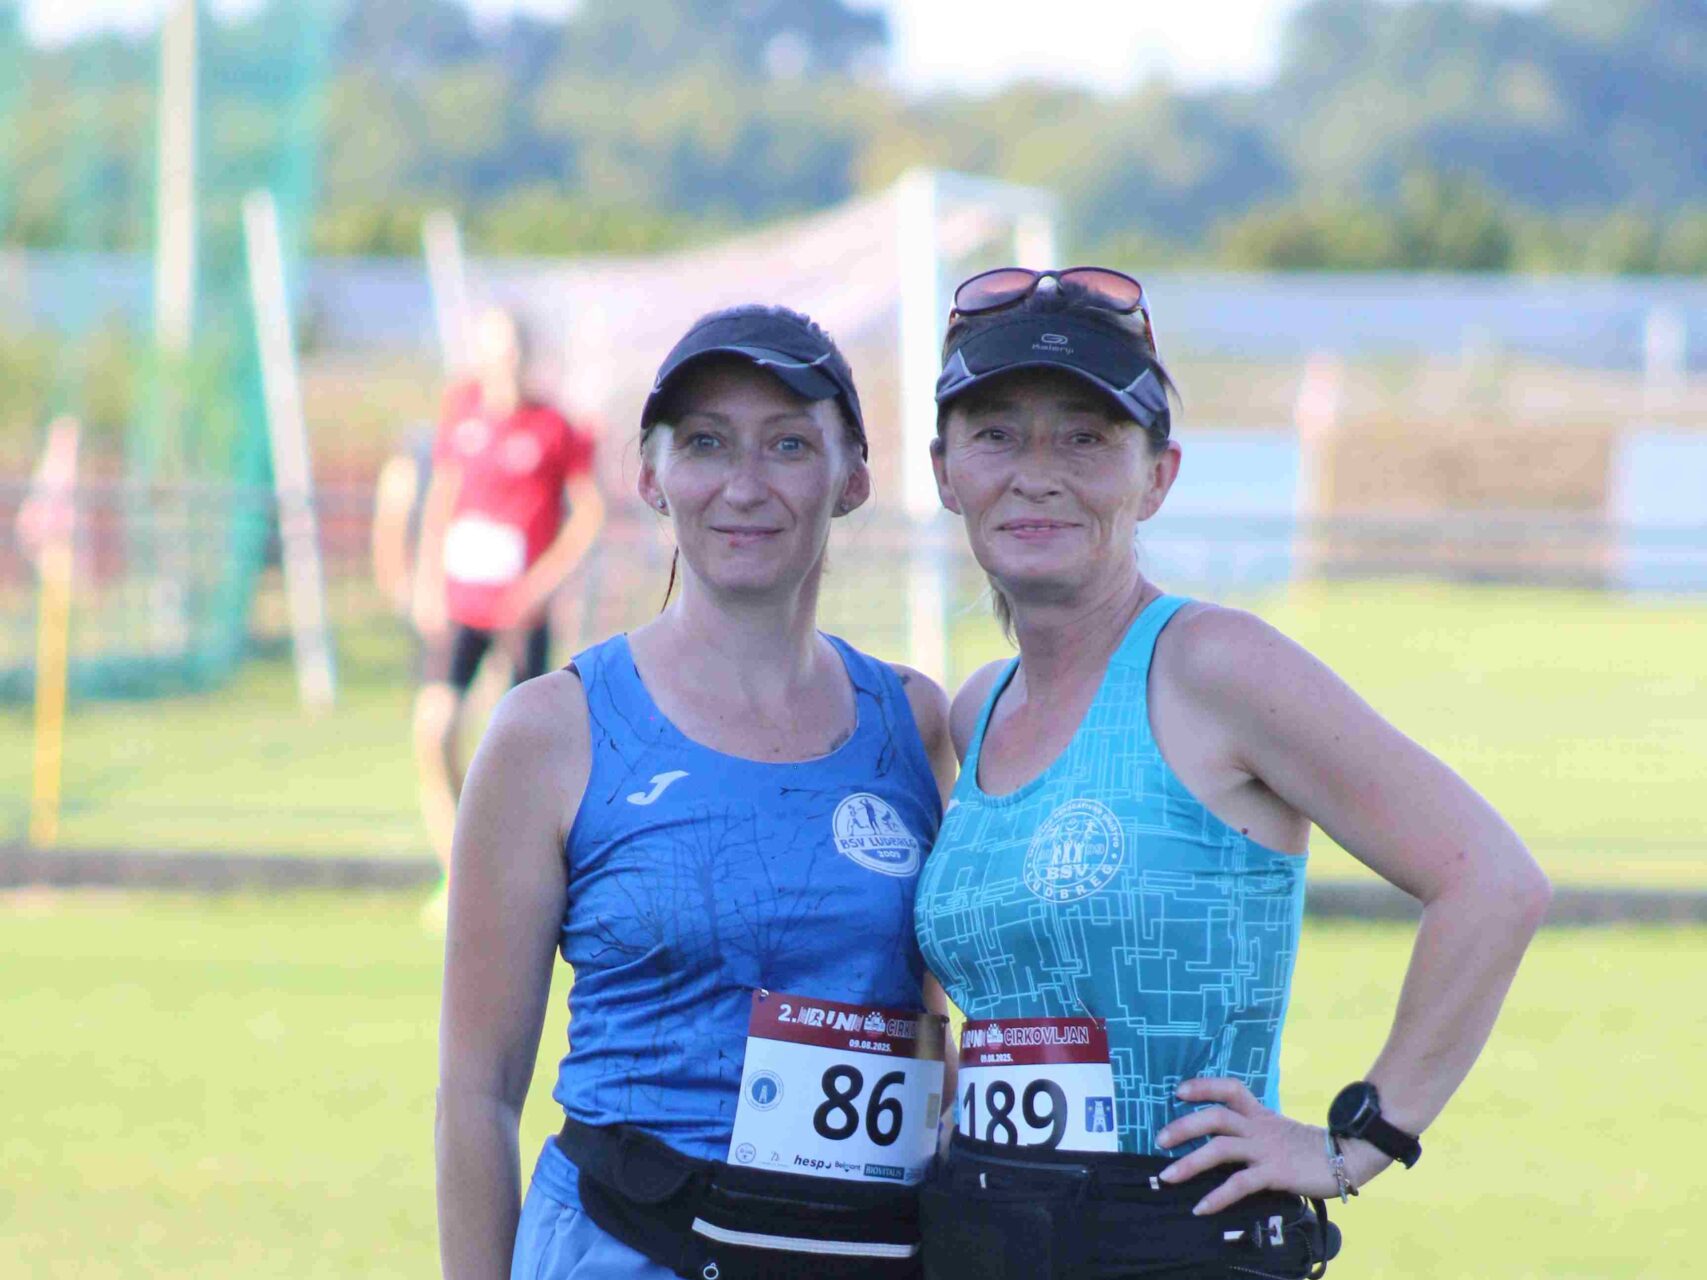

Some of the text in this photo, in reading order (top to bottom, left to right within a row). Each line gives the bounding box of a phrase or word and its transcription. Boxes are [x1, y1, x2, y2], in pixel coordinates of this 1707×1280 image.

[839, 837, 865, 849] BSV
[1046, 863, 1089, 880] BSV
[1026, 864, 1114, 900] LUDBREG
[777, 1003, 797, 1023] 2.
[1004, 1026, 1090, 1046] CIRKOVLJAN
[812, 1063, 906, 1147] 86
[963, 1078, 1068, 1150] 189
